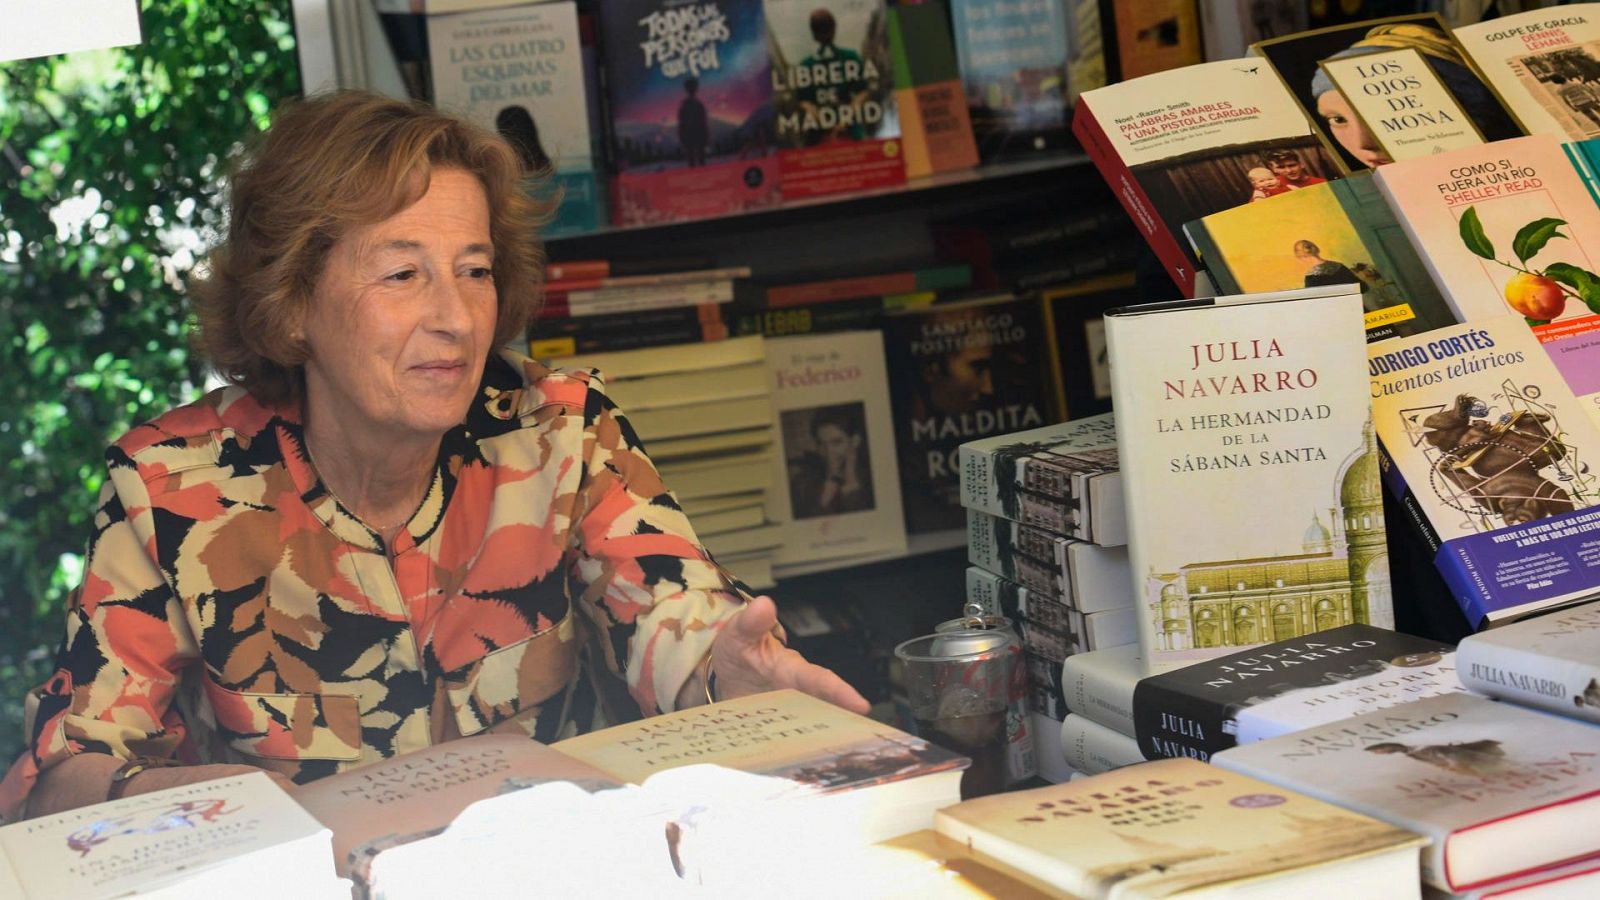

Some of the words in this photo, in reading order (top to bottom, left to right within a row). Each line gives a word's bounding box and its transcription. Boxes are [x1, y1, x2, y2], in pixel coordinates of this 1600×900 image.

[1485, 27, 1525, 42] GOLPE
[1526, 24, 1541, 32] DE
[1543, 17, 1587, 29] GRACIA
[1520, 29, 1565, 43] DENNIS
[1526, 36, 1574, 51] LEHANE
[450, 45, 482, 63] LAS
[489, 38, 565, 60] CUATRO
[462, 60, 557, 82] ESQUINAS
[771, 59, 879, 91] LIBRERA
[1356, 60, 1402, 78] LOS
[510, 80, 553, 98] MAR
[816, 88, 838, 103] DE
[1363, 76, 1422, 96] OJOS
[1115, 114, 1134, 125] Noel
[1166, 101, 1190, 111] Smith
[1120, 112, 1178, 132] PALABRAS
[1180, 101, 1232, 118] AMABLES
[1387, 95, 1423, 111] DE
[776, 100, 881, 136] MADRID
[1124, 132, 1133, 141] Y
[1135, 127, 1160, 139] UNA
[1160, 116, 1203, 131] PISTOLA
[1205, 106, 1261, 121] CARGADA
[1380, 110, 1454, 132] MONA
[1437, 177, 1485, 194] FUERA
[1486, 172, 1509, 184] UN
[1510, 166, 1536, 179] RÍO
[1450, 162, 1496, 178] COMO
[1498, 159, 1513, 170] SI
[1444, 184, 1501, 205] SHELLEY
[1504, 178, 1543, 192] READ
[921, 313, 1013, 337] SANTIAGO
[1365, 309, 1407, 324] AMARILLO
[910, 326, 1026, 356] POSTEGUILLO
[1190, 338, 1284, 371] JULIA
[1428, 328, 1495, 361] CORTÉS
[775, 365, 862, 390] Federico
[1164, 368, 1318, 401] NAVARRO
[1370, 370, 1443, 398] Cuentos
[1445, 350, 1525, 379] telúricos
[911, 404, 1042, 442] MALDITA
[1156, 417, 1184, 433] LA
[1191, 404, 1332, 430] HERMANDAD
[1222, 434, 1243, 446] DE
[1251, 432, 1270, 444] LA
[1170, 453, 1251, 473] SÁBANA
[1260, 447, 1327, 466] SANTA
[1492, 532, 1518, 543] VUELVE
[1518, 529, 1528, 538] EL
[1528, 524, 1551, 535] AUTOR
[1522, 535, 1540, 546] MÁS
[1539, 533, 1550, 542] DE
[1458, 548, 1474, 570] HOUSE
[1472, 571, 1492, 600] RANDOM
[1205, 640, 1377, 688] NAVARRO
[1220, 642, 1327, 673] JULIA
[1304, 667, 1456, 707] HISTORIA
[1359, 692, 1398, 704] DE
[1403, 681, 1441, 693] UN
[1470, 662, 1506, 687] JULIA
[1508, 671, 1566, 700] NAVARRO
[621, 707, 778, 747] NAVARRO
[641, 708, 734, 733] JULIA
[682, 713, 799, 741] SANGRE
[1161, 712, 1204, 740] JULIA
[1299, 715, 1411, 748] JULIA
[645, 722, 830, 767] INOCENTES
[1152, 736, 1210, 764] NAVARR
[1283, 711, 1459, 761] NAVARRO
[341, 749, 503, 796] NAVARRO
[361, 752, 460, 782] JULIA
[1015, 778, 1225, 822] NAVARRO
[1035, 779, 1170, 811] JULIA
